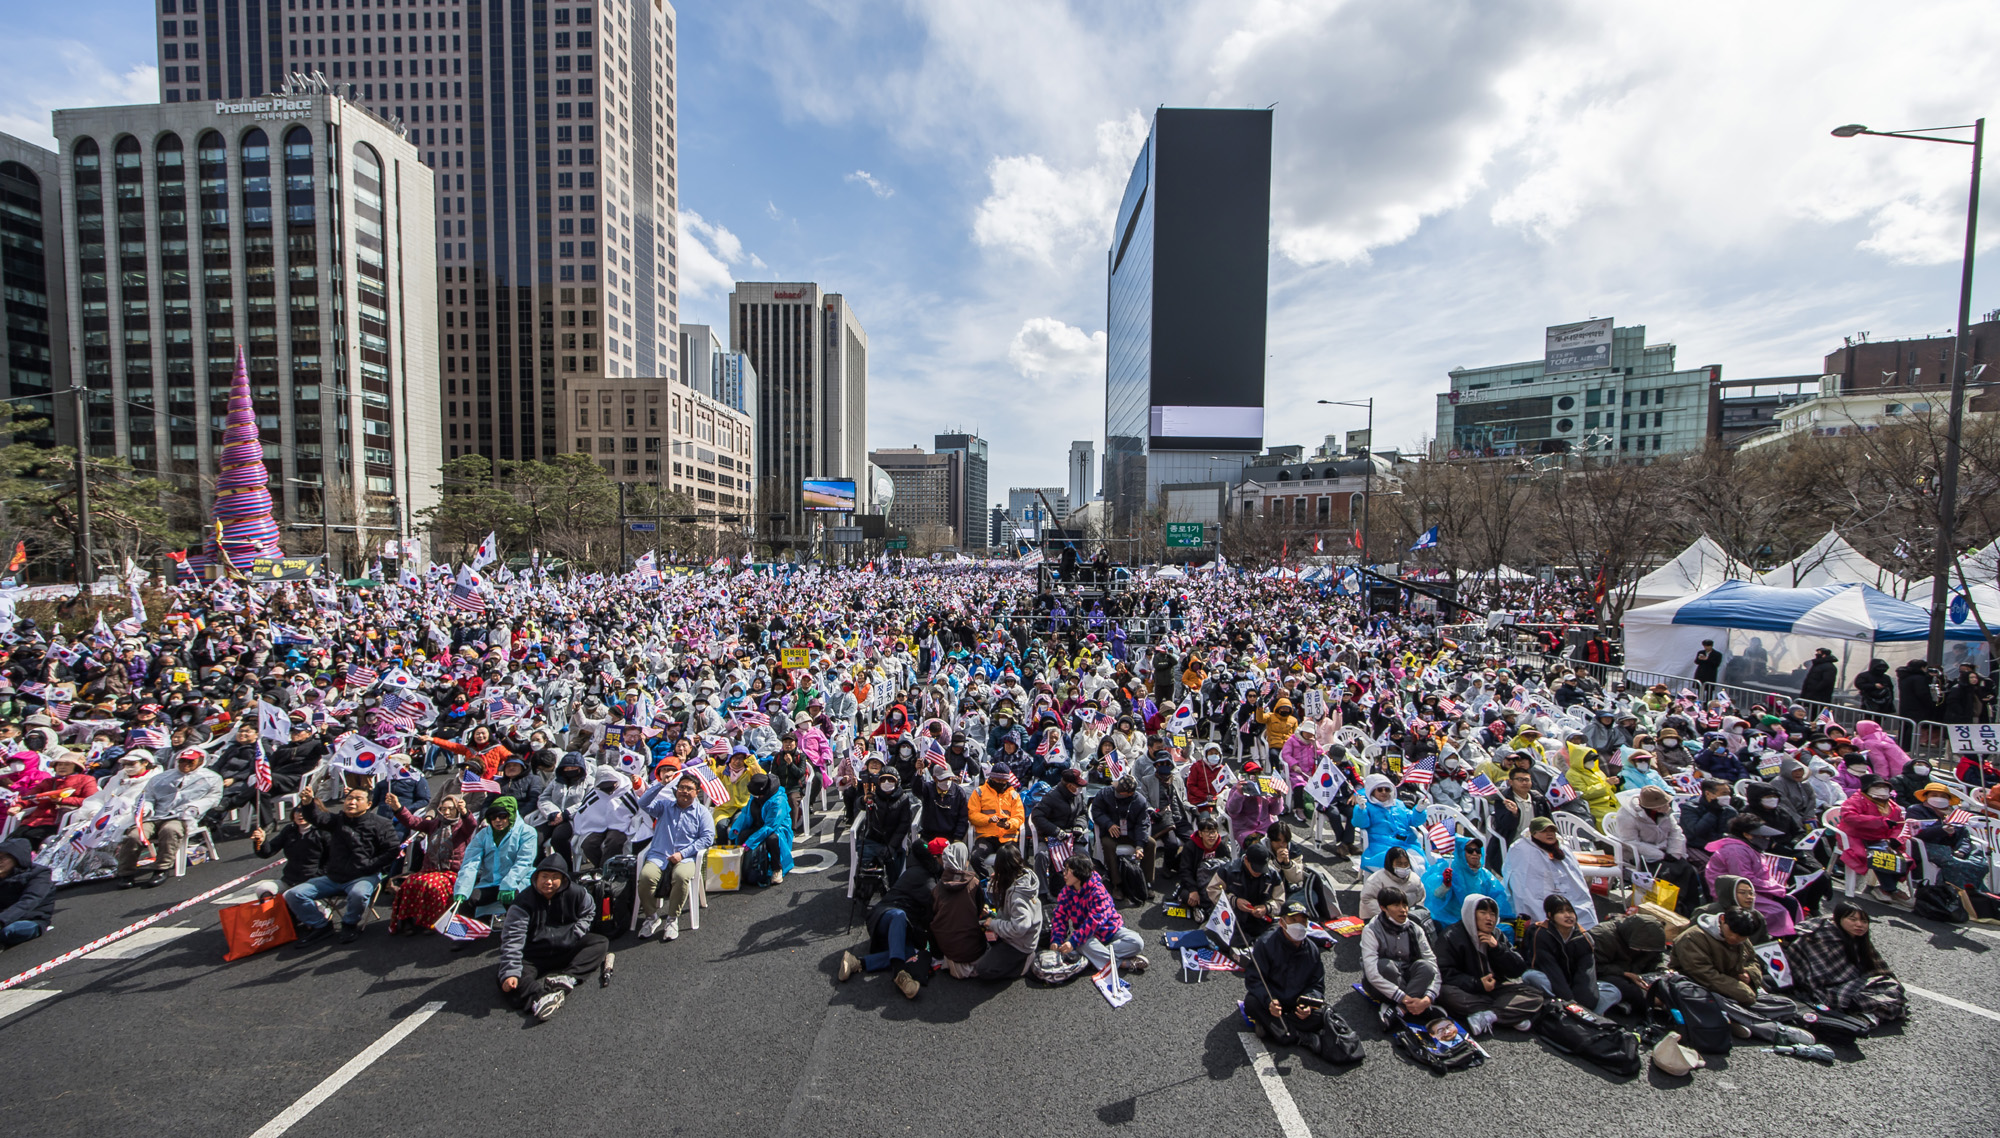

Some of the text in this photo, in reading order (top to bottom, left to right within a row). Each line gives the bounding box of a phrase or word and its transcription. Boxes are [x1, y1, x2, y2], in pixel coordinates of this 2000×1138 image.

[216, 99, 312, 114] Premier Place
[1550, 356, 1579, 366] TOEFL
[1169, 524, 1199, 533] 종로1가
[784, 649, 807, 657] 경북의성
[1955, 725, 1996, 738] 정읍
[1958, 739, 1999, 752] 고창
[251, 917, 275, 928] Happy
[250, 925, 280, 938] always
[251, 936, 274, 947] Here
